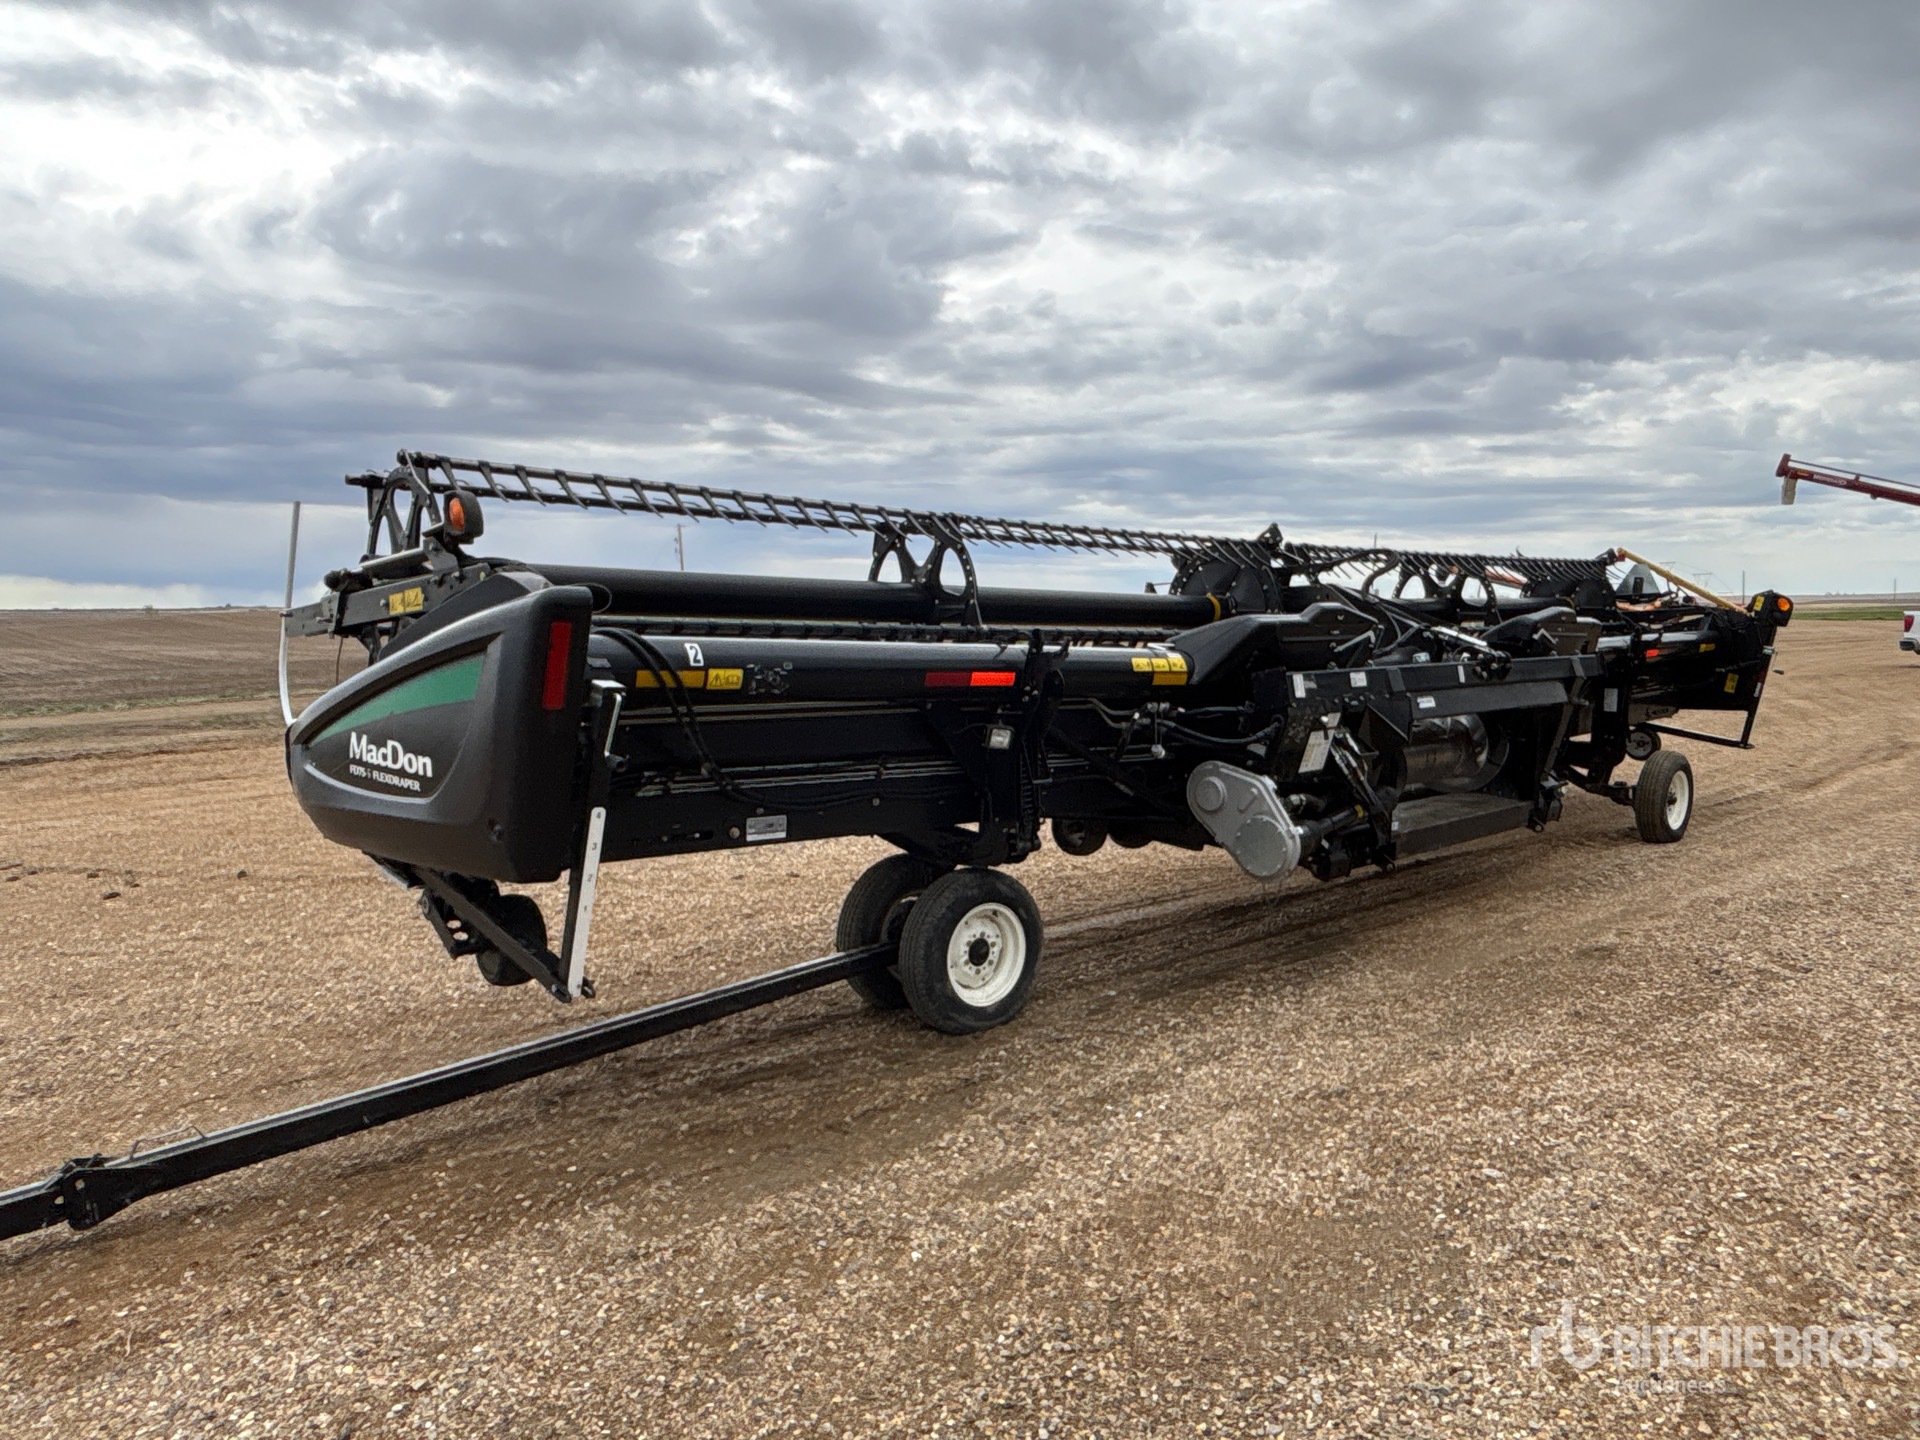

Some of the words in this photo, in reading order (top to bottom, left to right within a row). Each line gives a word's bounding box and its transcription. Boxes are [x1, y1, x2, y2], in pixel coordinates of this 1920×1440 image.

[689, 645, 702, 664] 2
[349, 731, 433, 778] MacDon
[372, 769, 421, 792] FLEXDRAPER
